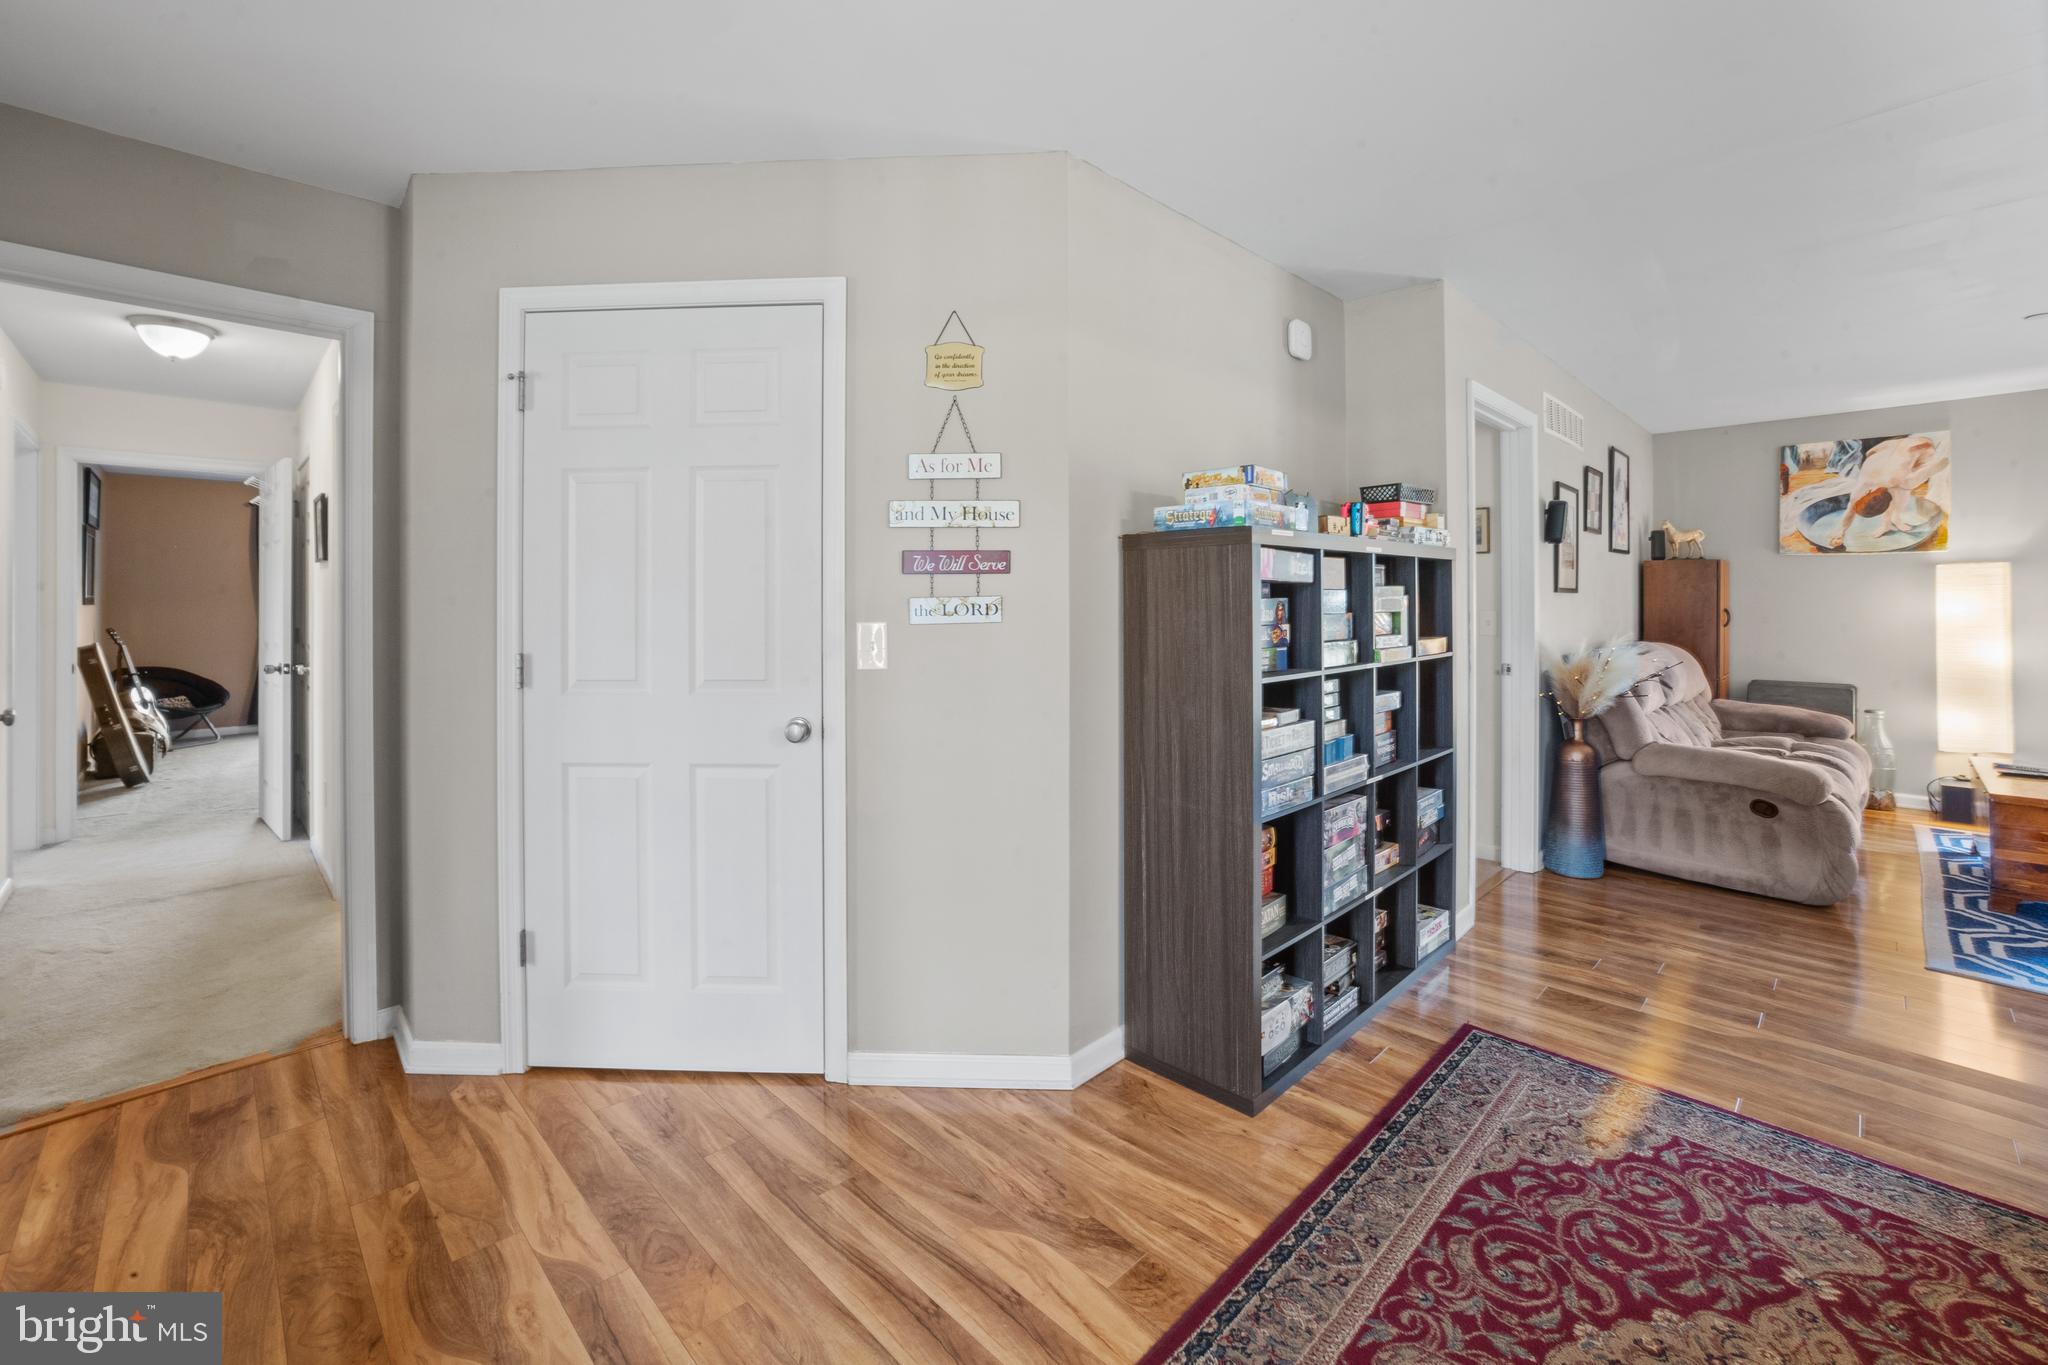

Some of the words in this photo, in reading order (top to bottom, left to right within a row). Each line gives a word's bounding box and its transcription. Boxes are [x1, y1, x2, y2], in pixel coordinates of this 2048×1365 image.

[914, 458, 936, 473] As
[941, 457, 963, 473] for
[967, 457, 993, 473] Me
[895, 506, 924, 521] and
[931, 506, 957, 525] My
[962, 505, 1015, 521] House
[1165, 507, 1215, 525] Stratego
[913, 555, 936, 572] We
[938, 554, 970, 571] Will
[968, 553, 1007, 571] Serve
[914, 603, 937, 617] the
[942, 602, 999, 617] LORD
